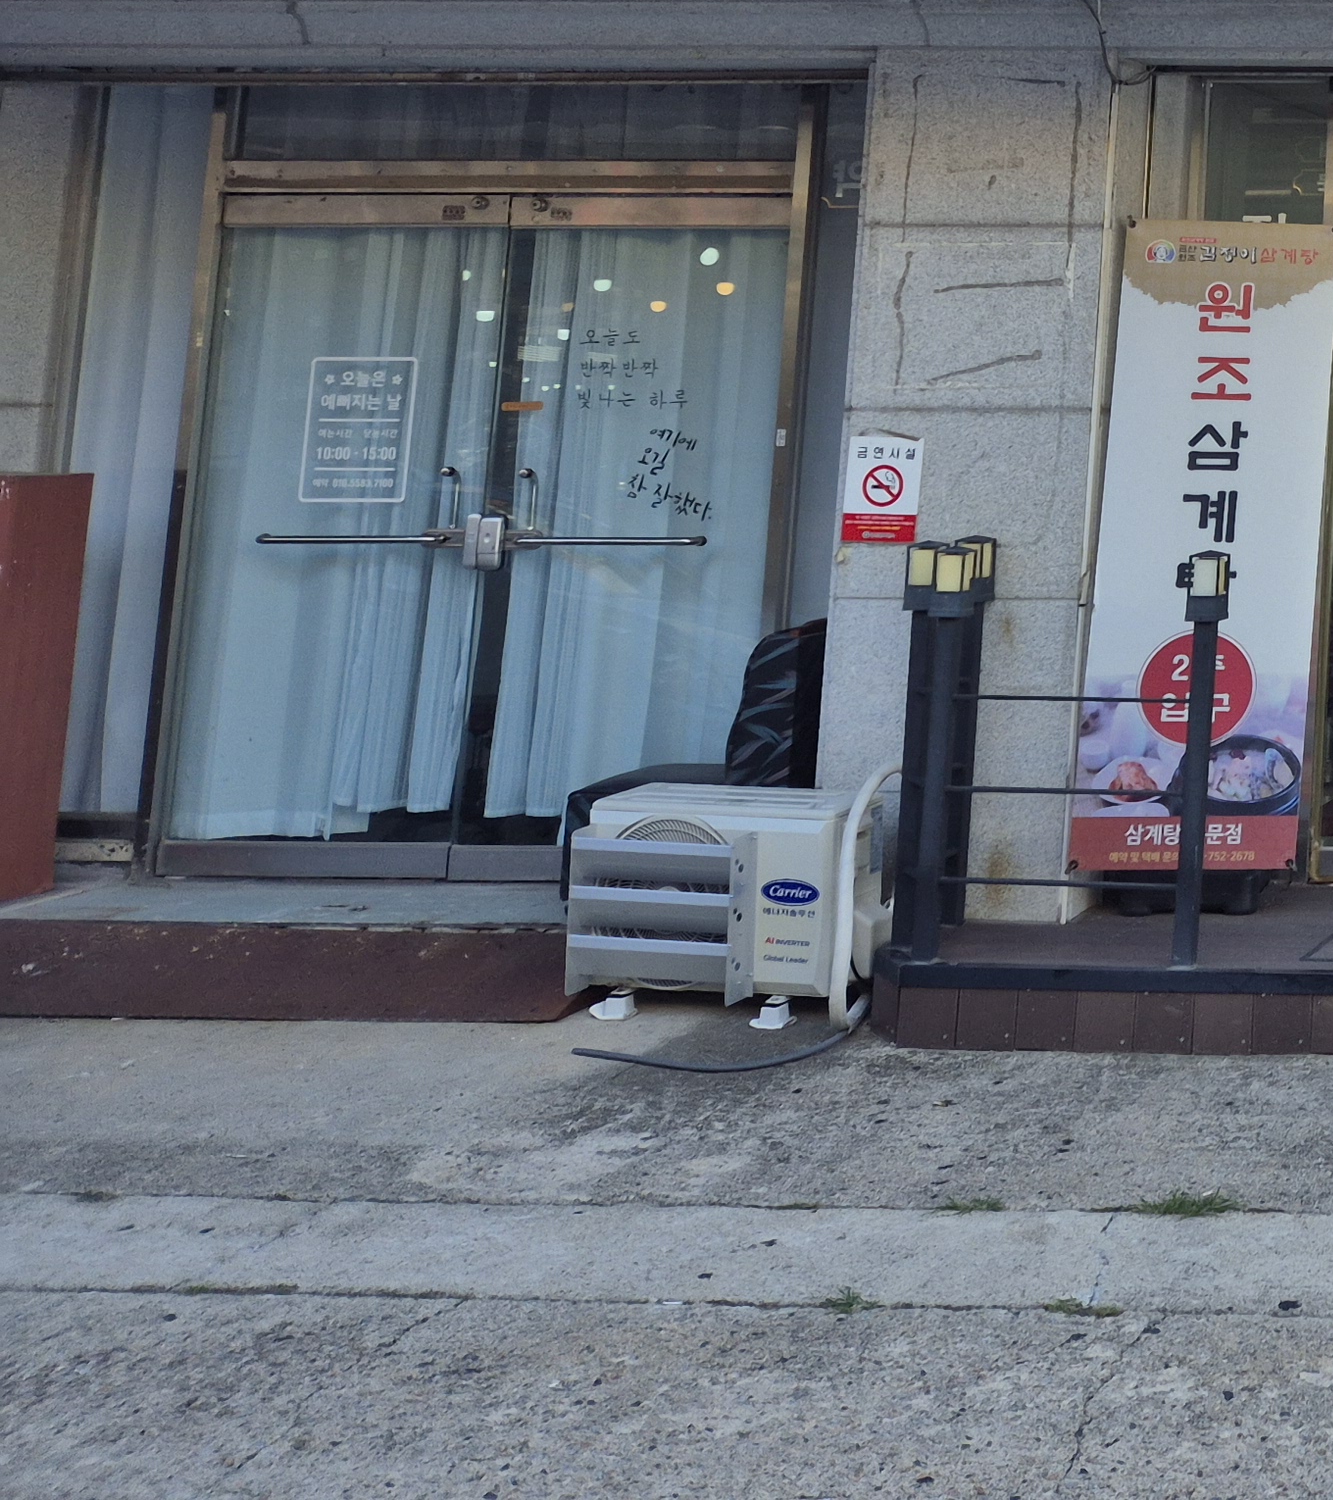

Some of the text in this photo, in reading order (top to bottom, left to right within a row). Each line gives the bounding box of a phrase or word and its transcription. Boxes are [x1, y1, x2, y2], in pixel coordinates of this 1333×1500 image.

[1190, 283, 1254, 402] 원조
[340, 370, 387, 388] 오늘은
[316, 446, 397, 461] 10:00 15:00
[857, 446, 916, 461] 금연시설
[1124, 823, 1243, 847] 삼계탕 문점
[769, 884, 813, 899] Carrier
